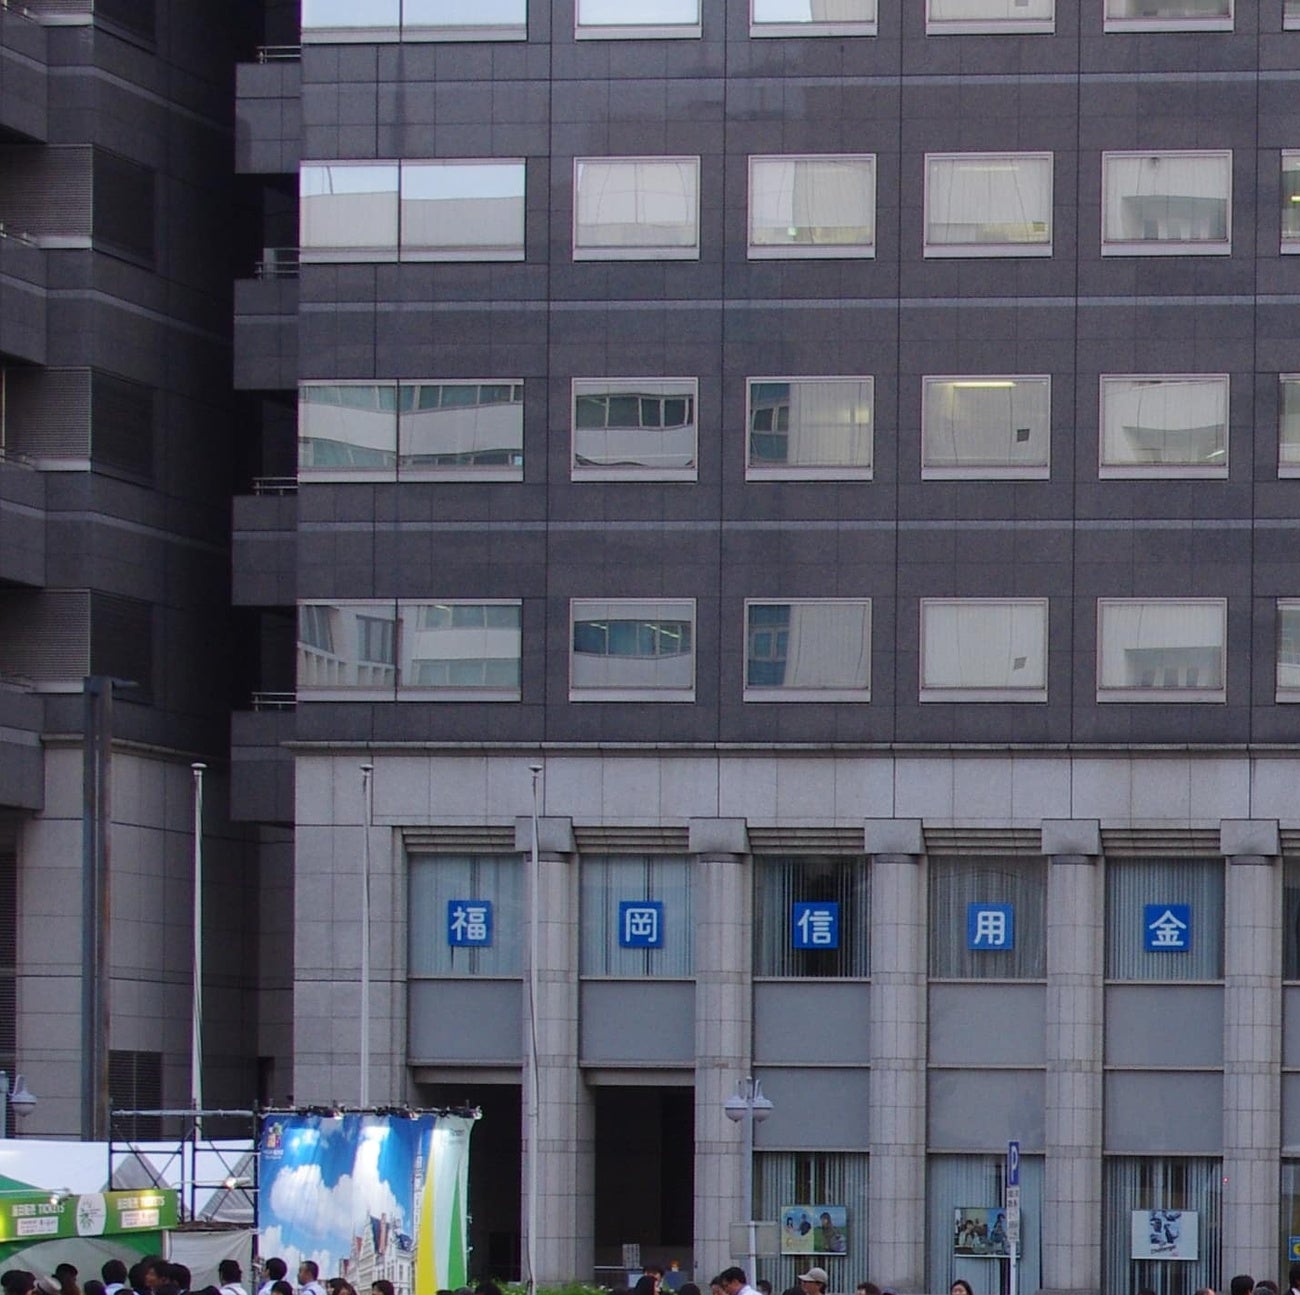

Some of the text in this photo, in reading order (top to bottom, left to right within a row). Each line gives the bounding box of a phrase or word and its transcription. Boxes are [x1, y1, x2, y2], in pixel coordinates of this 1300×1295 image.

[451, 906, 487, 941] 福
[625, 908, 657, 943] 岡
[797, 909, 833, 944] 信
[974, 910, 1006, 946] 用
[1149, 910, 1187, 947] 金
[1011, 1145, 1018, 1182] P
